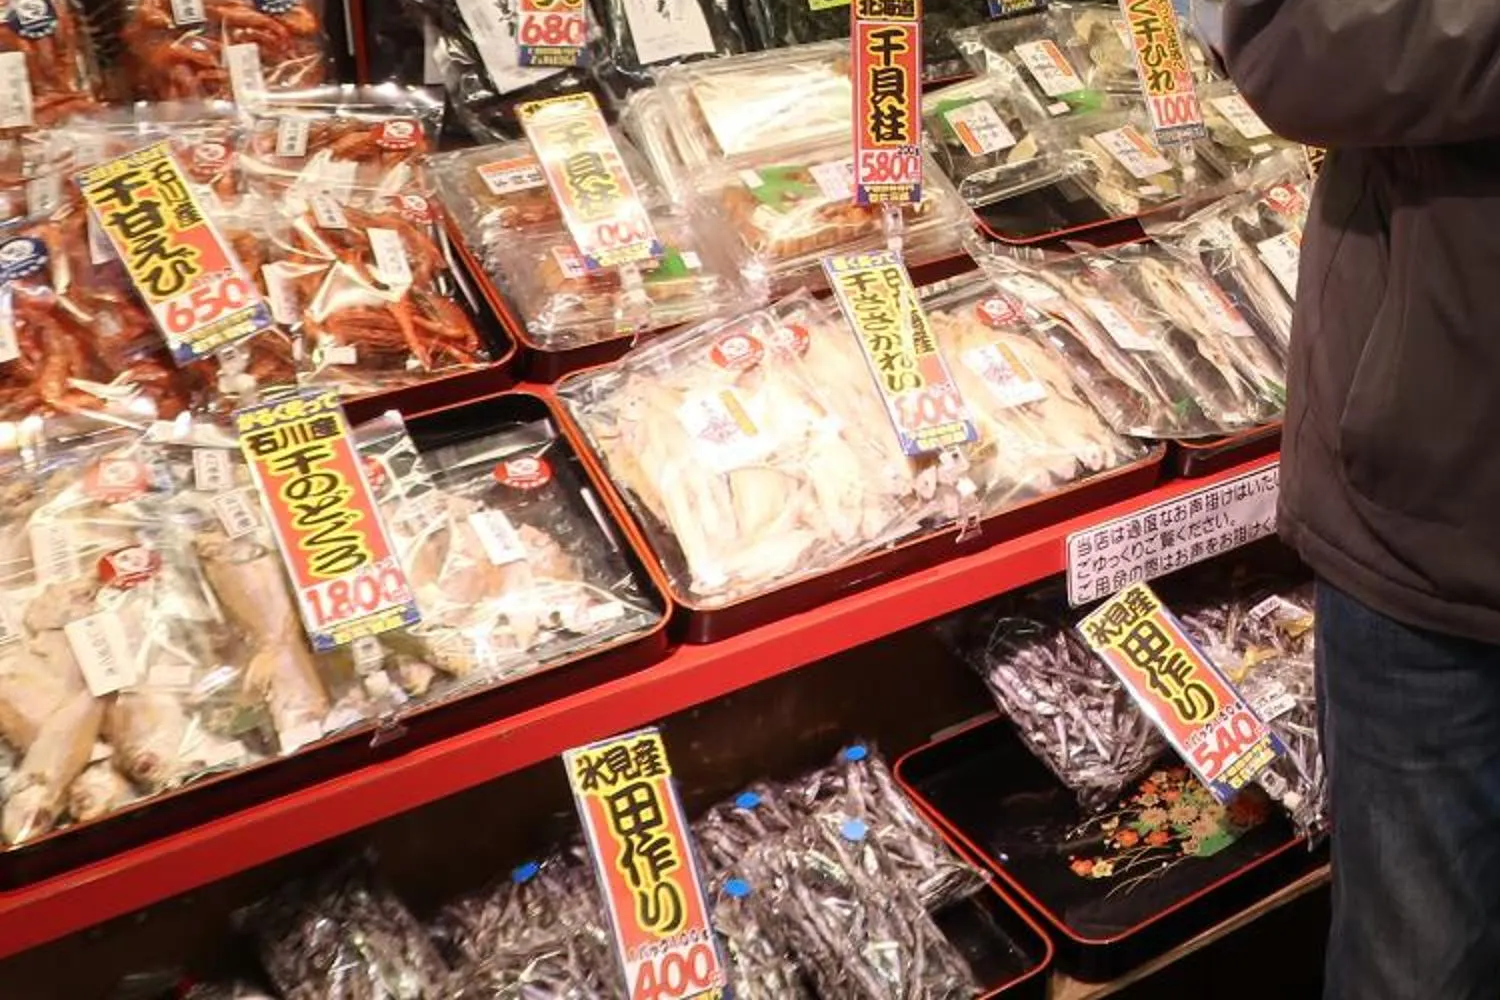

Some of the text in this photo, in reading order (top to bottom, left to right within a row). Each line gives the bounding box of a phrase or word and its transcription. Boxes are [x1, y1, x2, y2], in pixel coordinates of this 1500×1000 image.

[521, 15, 589, 45] 680
[860, 0, 915, 17] 北海道
[869, 28, 906, 142] 干貝柱
[152, 161, 204, 228] 石川産
[166, 278, 248, 333] 650
[246, 416, 341, 456] 石川産
[272, 445, 368, 575] 干のどぐろ
[1086, 586, 1159, 645] 氷見産
[1118, 619, 1216, 721] 田作り
[576, 738, 666, 791] 氷見産
[604, 781, 684, 933] 田作り
